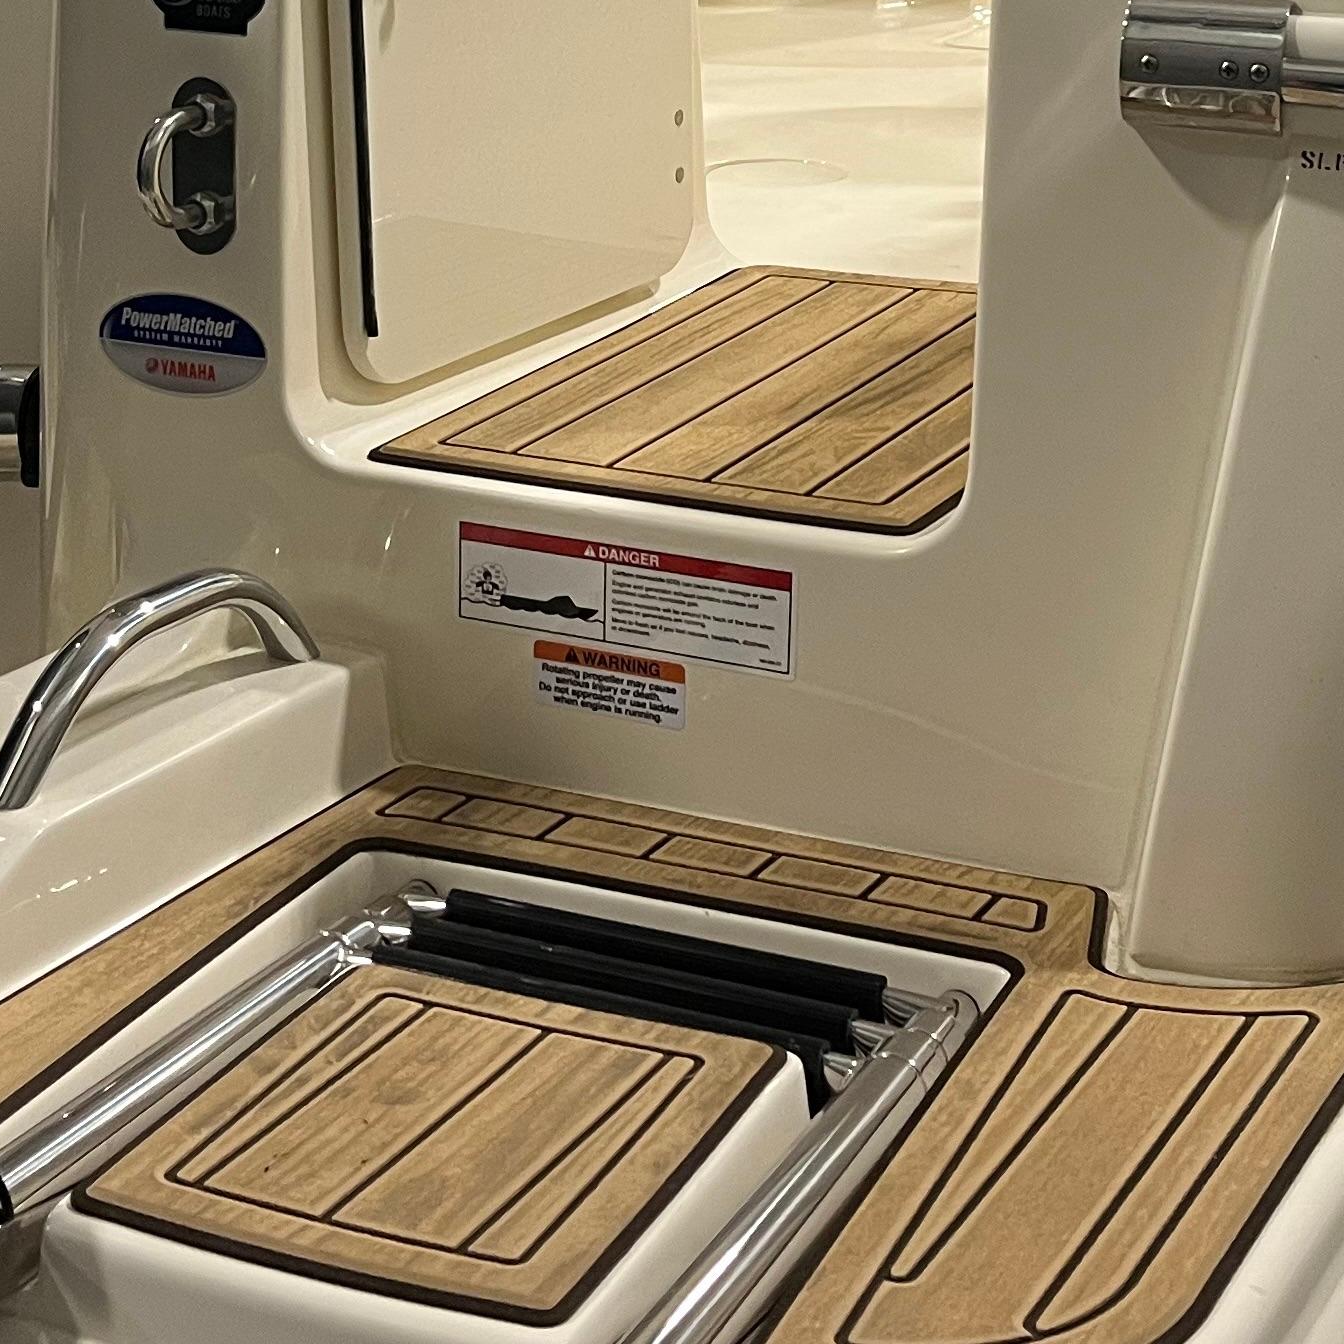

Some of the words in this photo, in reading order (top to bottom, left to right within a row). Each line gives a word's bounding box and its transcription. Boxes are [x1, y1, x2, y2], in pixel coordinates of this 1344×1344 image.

[195, 4, 232, 18] BOATS
[121, 307, 236, 339] PowerMatched
[160, 358, 216, 382] YAMAHA
[598, 545, 660, 568] DANGER
[582, 650, 661, 677] WARNING
[541, 662, 581, 679] Rotating
[626, 679, 646, 691] may
[538, 681, 552, 692] Do
[554, 685, 569, 695] not
[571, 689, 616, 703] approach
[617, 697, 627, 705] or
[629, 700, 647, 709] use
[620, 688, 631, 696] or
[580, 700, 612, 712] engine
[614, 705, 623, 714] is
